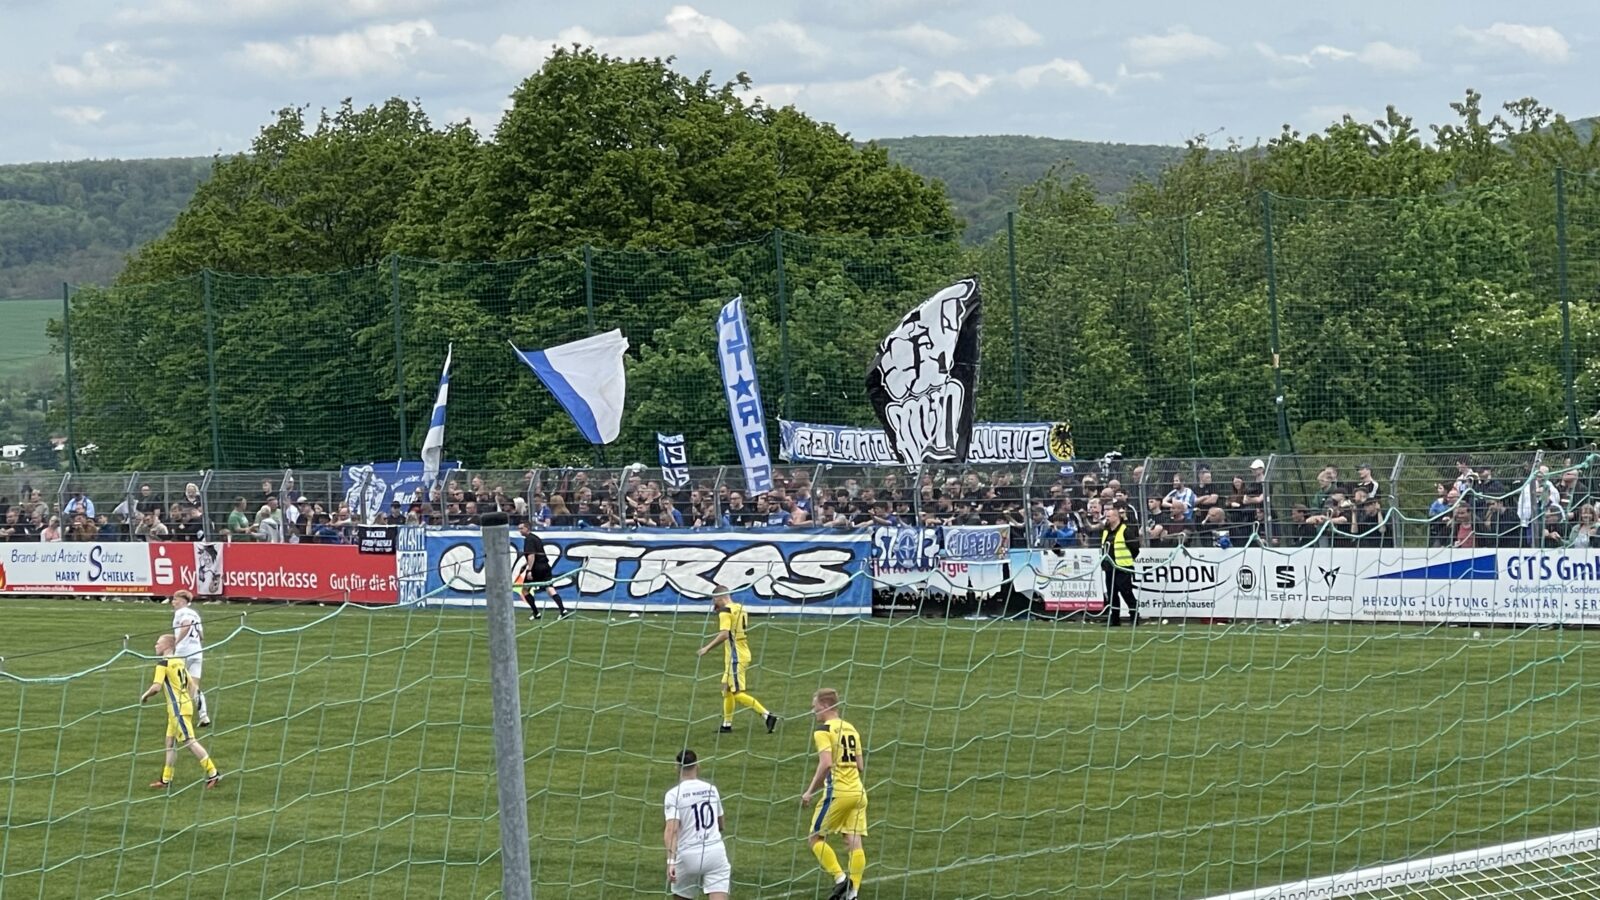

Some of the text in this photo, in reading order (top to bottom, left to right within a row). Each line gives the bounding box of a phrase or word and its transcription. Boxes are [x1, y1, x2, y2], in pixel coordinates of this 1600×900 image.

[11, 549, 39, 562] Brand-
[41, 552, 56, 562] und
[55, 572, 80, 581] HARRY
[180, 565, 318, 591] Kyusersparkasse
[1507, 556, 1552, 580] GTS
[330, 573, 398, 591] Gut für die R
[1362, 596, 1416, 607] HEIZUNG
[1431, 596, 1488, 608] LÜFTUNG
[1504, 597, 1558, 609] SANITÄR
[841, 735, 857, 762] 19
[691, 801, 714, 831] 10
